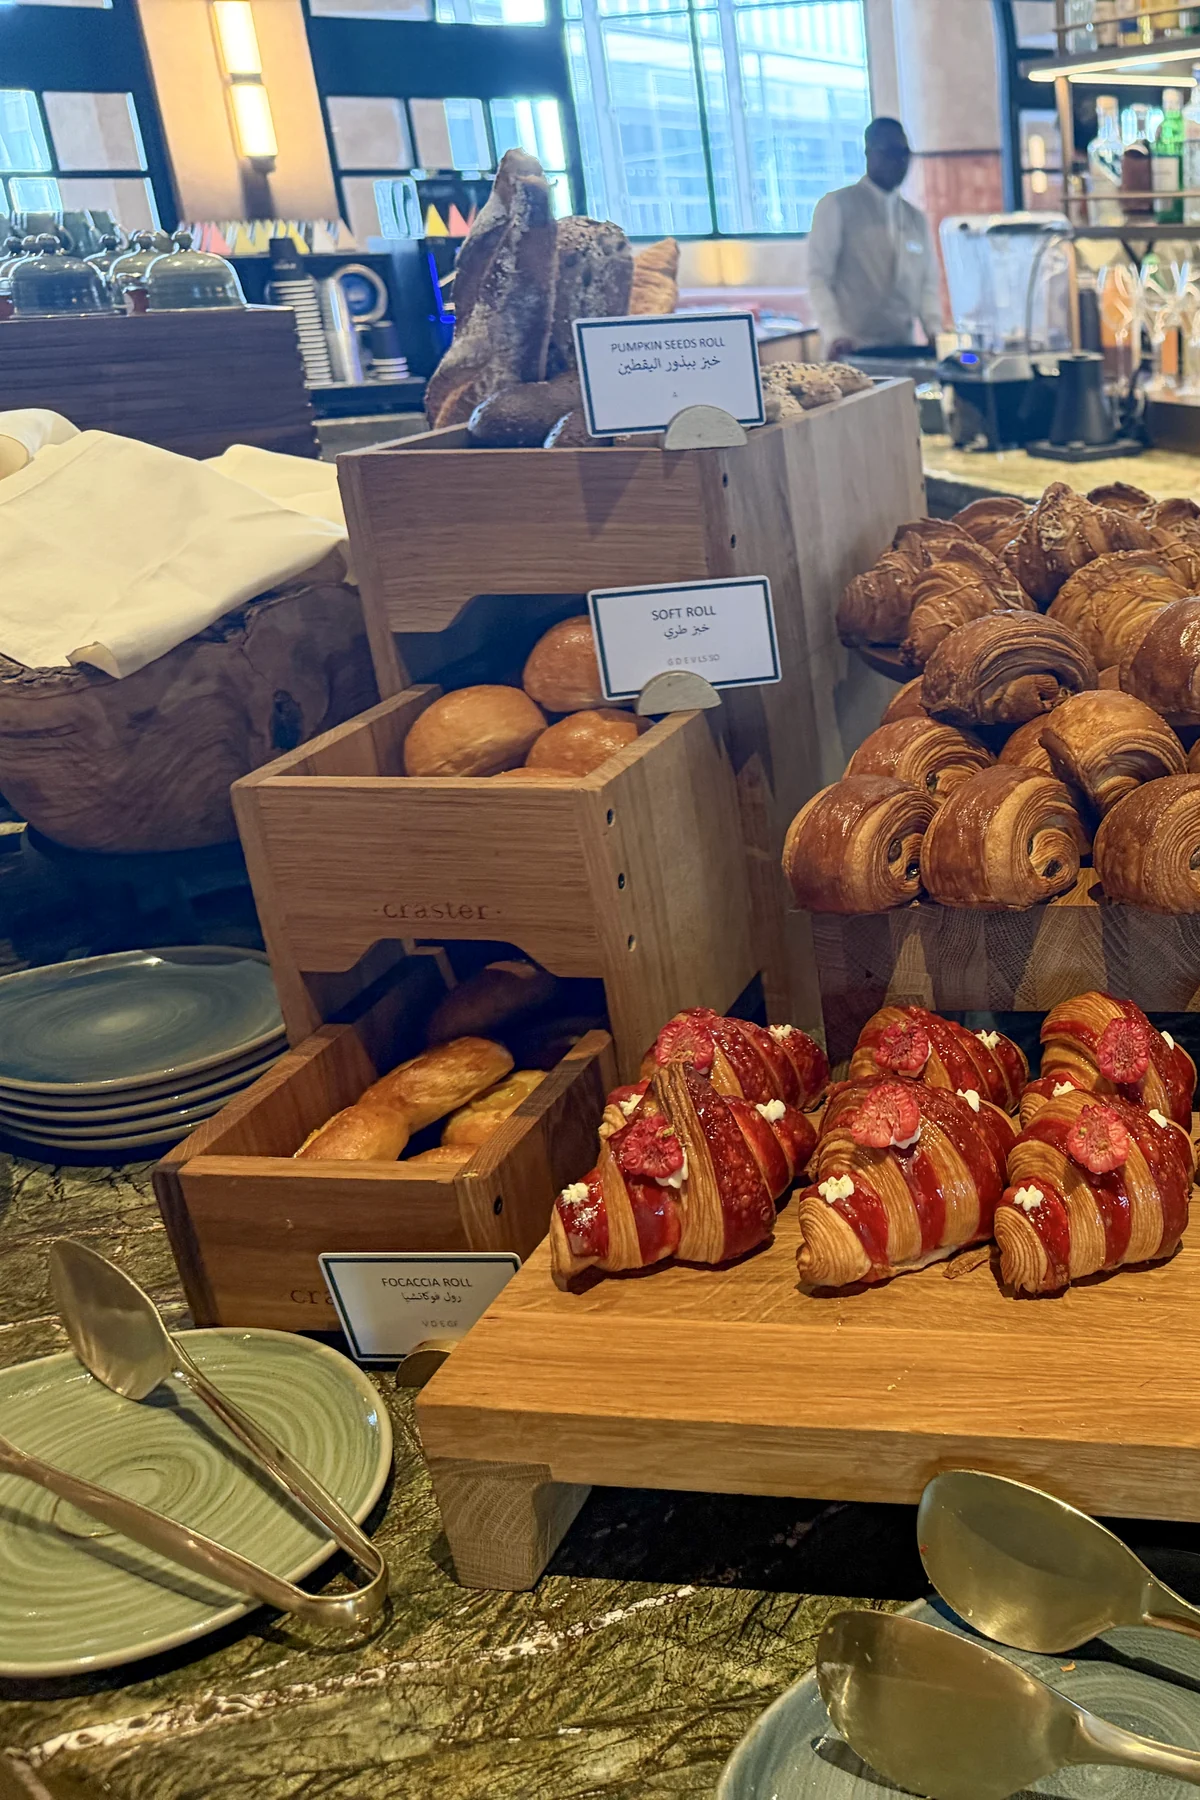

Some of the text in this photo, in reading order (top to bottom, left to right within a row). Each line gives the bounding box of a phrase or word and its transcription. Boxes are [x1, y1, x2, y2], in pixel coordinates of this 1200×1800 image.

[611, 337, 725, 353] PUMPKIN SEEDS ROLL
[618, 358, 661, 376] اليقطين
[700, 356, 721, 370] خبز
[651, 605, 716, 621] SOFT ROLL
[663, 624, 710, 640] خبز طري
[381, 1277, 473, 1288] FOCACCIA ROLL
